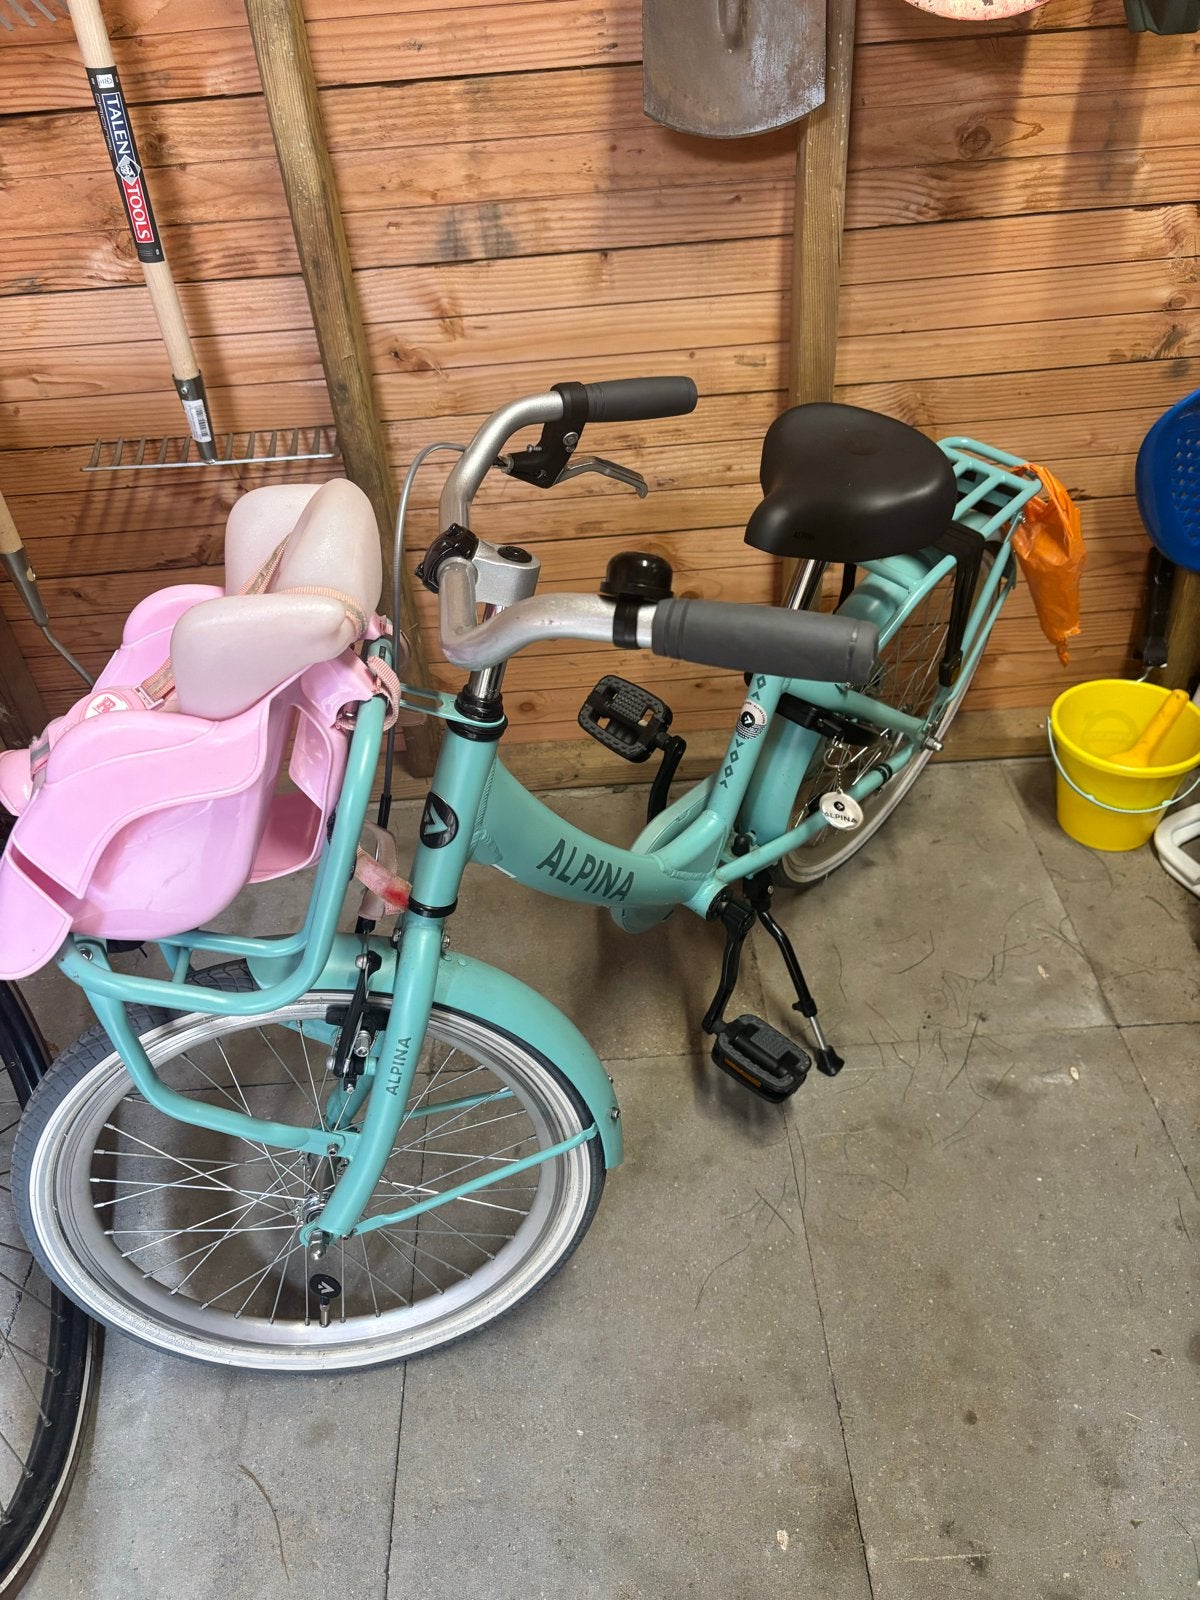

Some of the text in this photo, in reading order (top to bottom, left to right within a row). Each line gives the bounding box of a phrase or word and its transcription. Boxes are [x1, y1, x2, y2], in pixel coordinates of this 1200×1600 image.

[107, 94, 131, 156] TALEN
[127, 184, 150, 240] TOOLS
[824, 811, 858, 824] ALPINA
[535, 838, 635, 902] ALPINA
[385, 1036, 412, 1096] ALPINA
